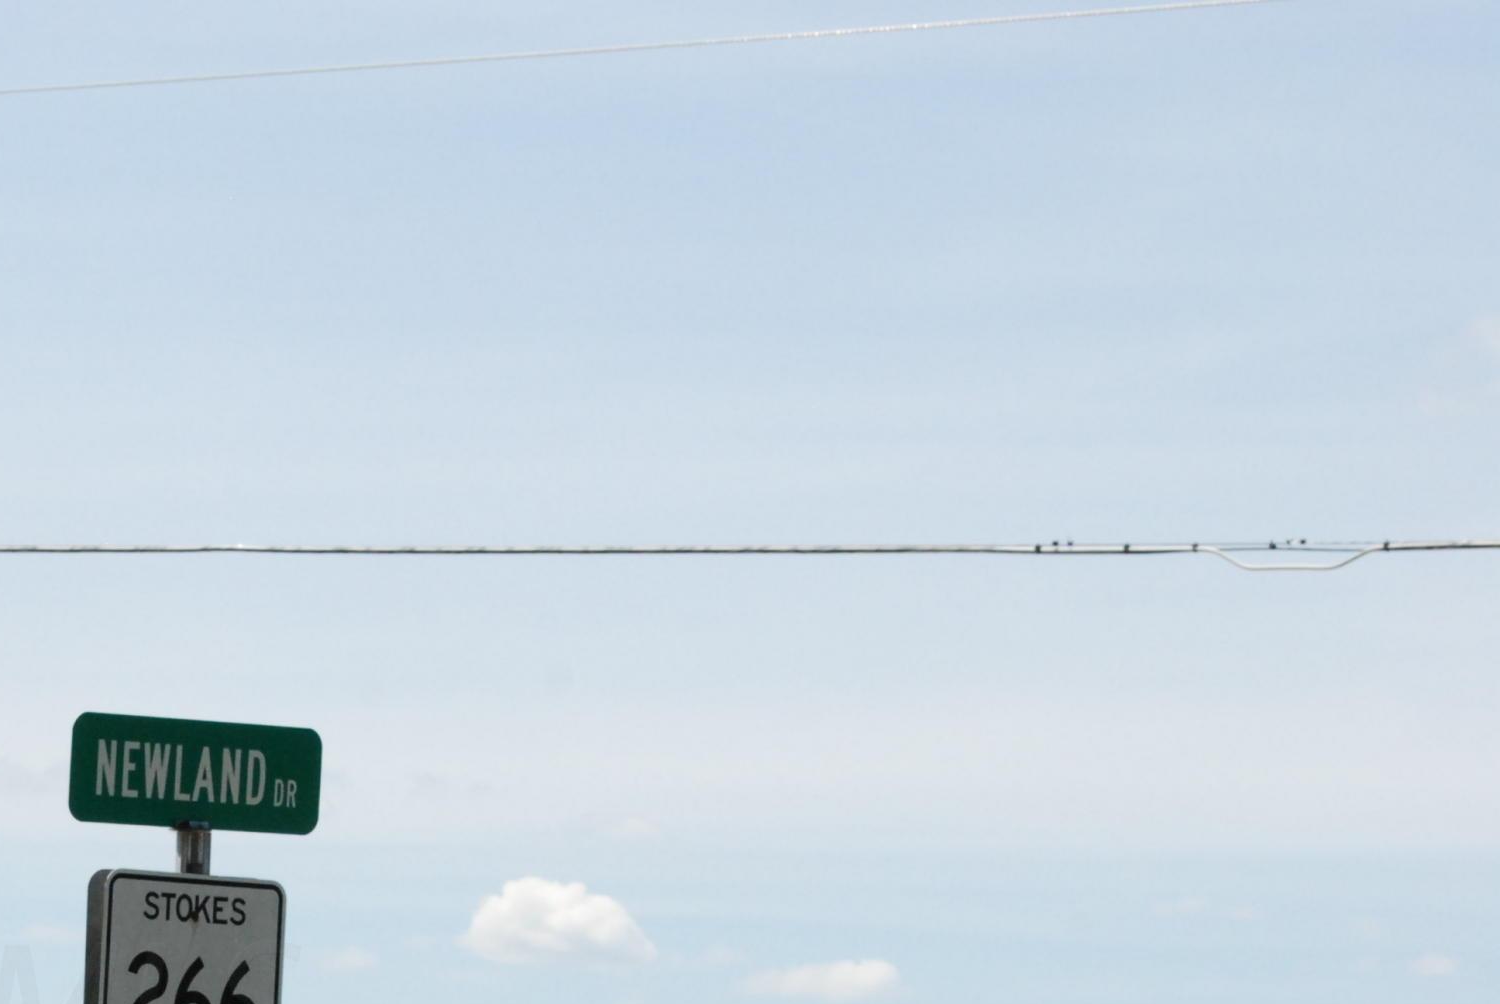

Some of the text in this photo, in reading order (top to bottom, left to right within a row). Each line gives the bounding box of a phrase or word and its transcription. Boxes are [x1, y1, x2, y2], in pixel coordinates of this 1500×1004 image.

[95, 738, 298, 808] NEWLAND DR
[143, 891, 246, 926] STOKES
